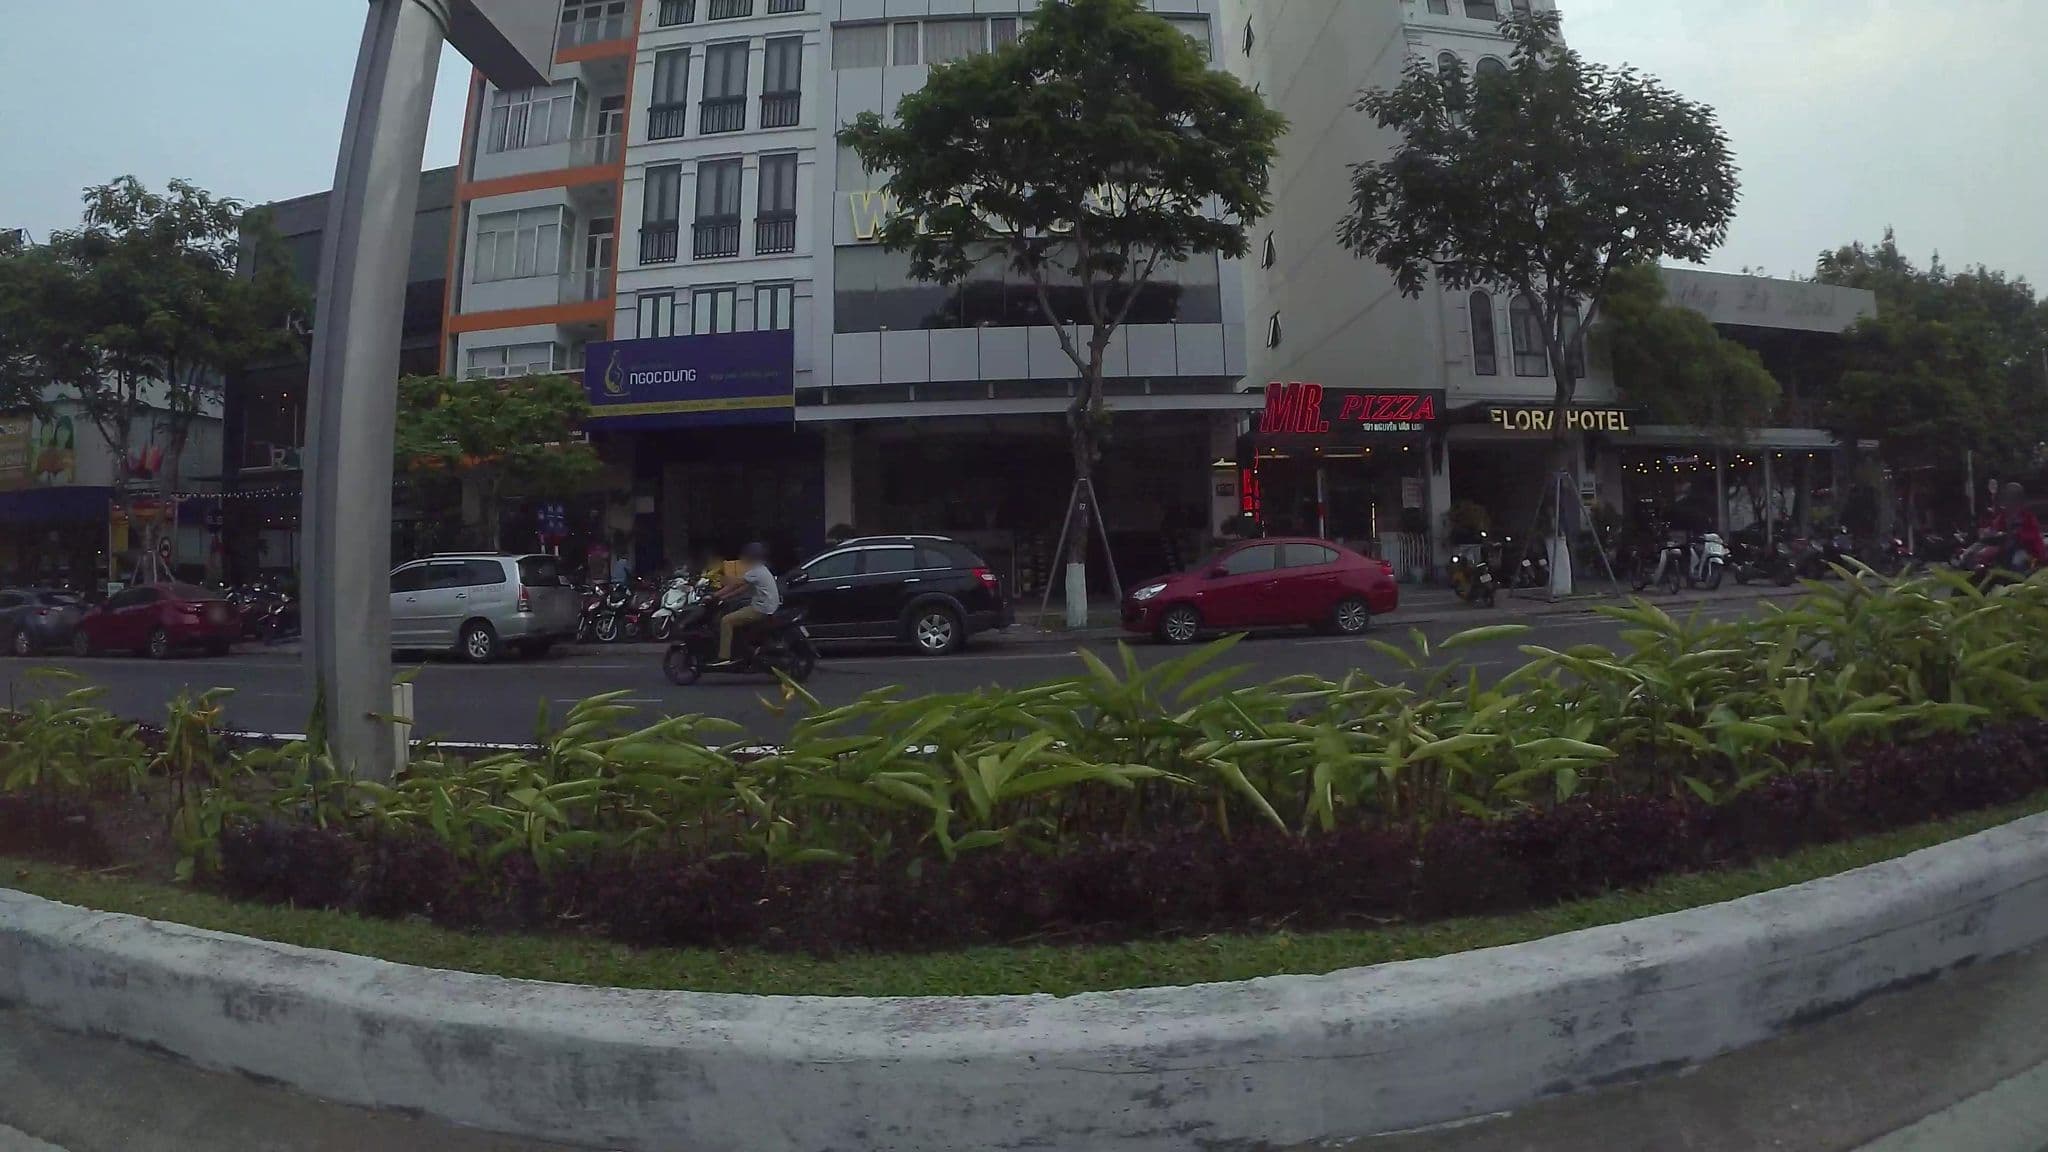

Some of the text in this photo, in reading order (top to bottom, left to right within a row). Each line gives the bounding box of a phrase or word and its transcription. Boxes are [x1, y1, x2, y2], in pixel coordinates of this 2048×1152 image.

[1260, 382, 1436, 432] MR. PIZZA
[1566, 410, 1629, 430] HOTEL
